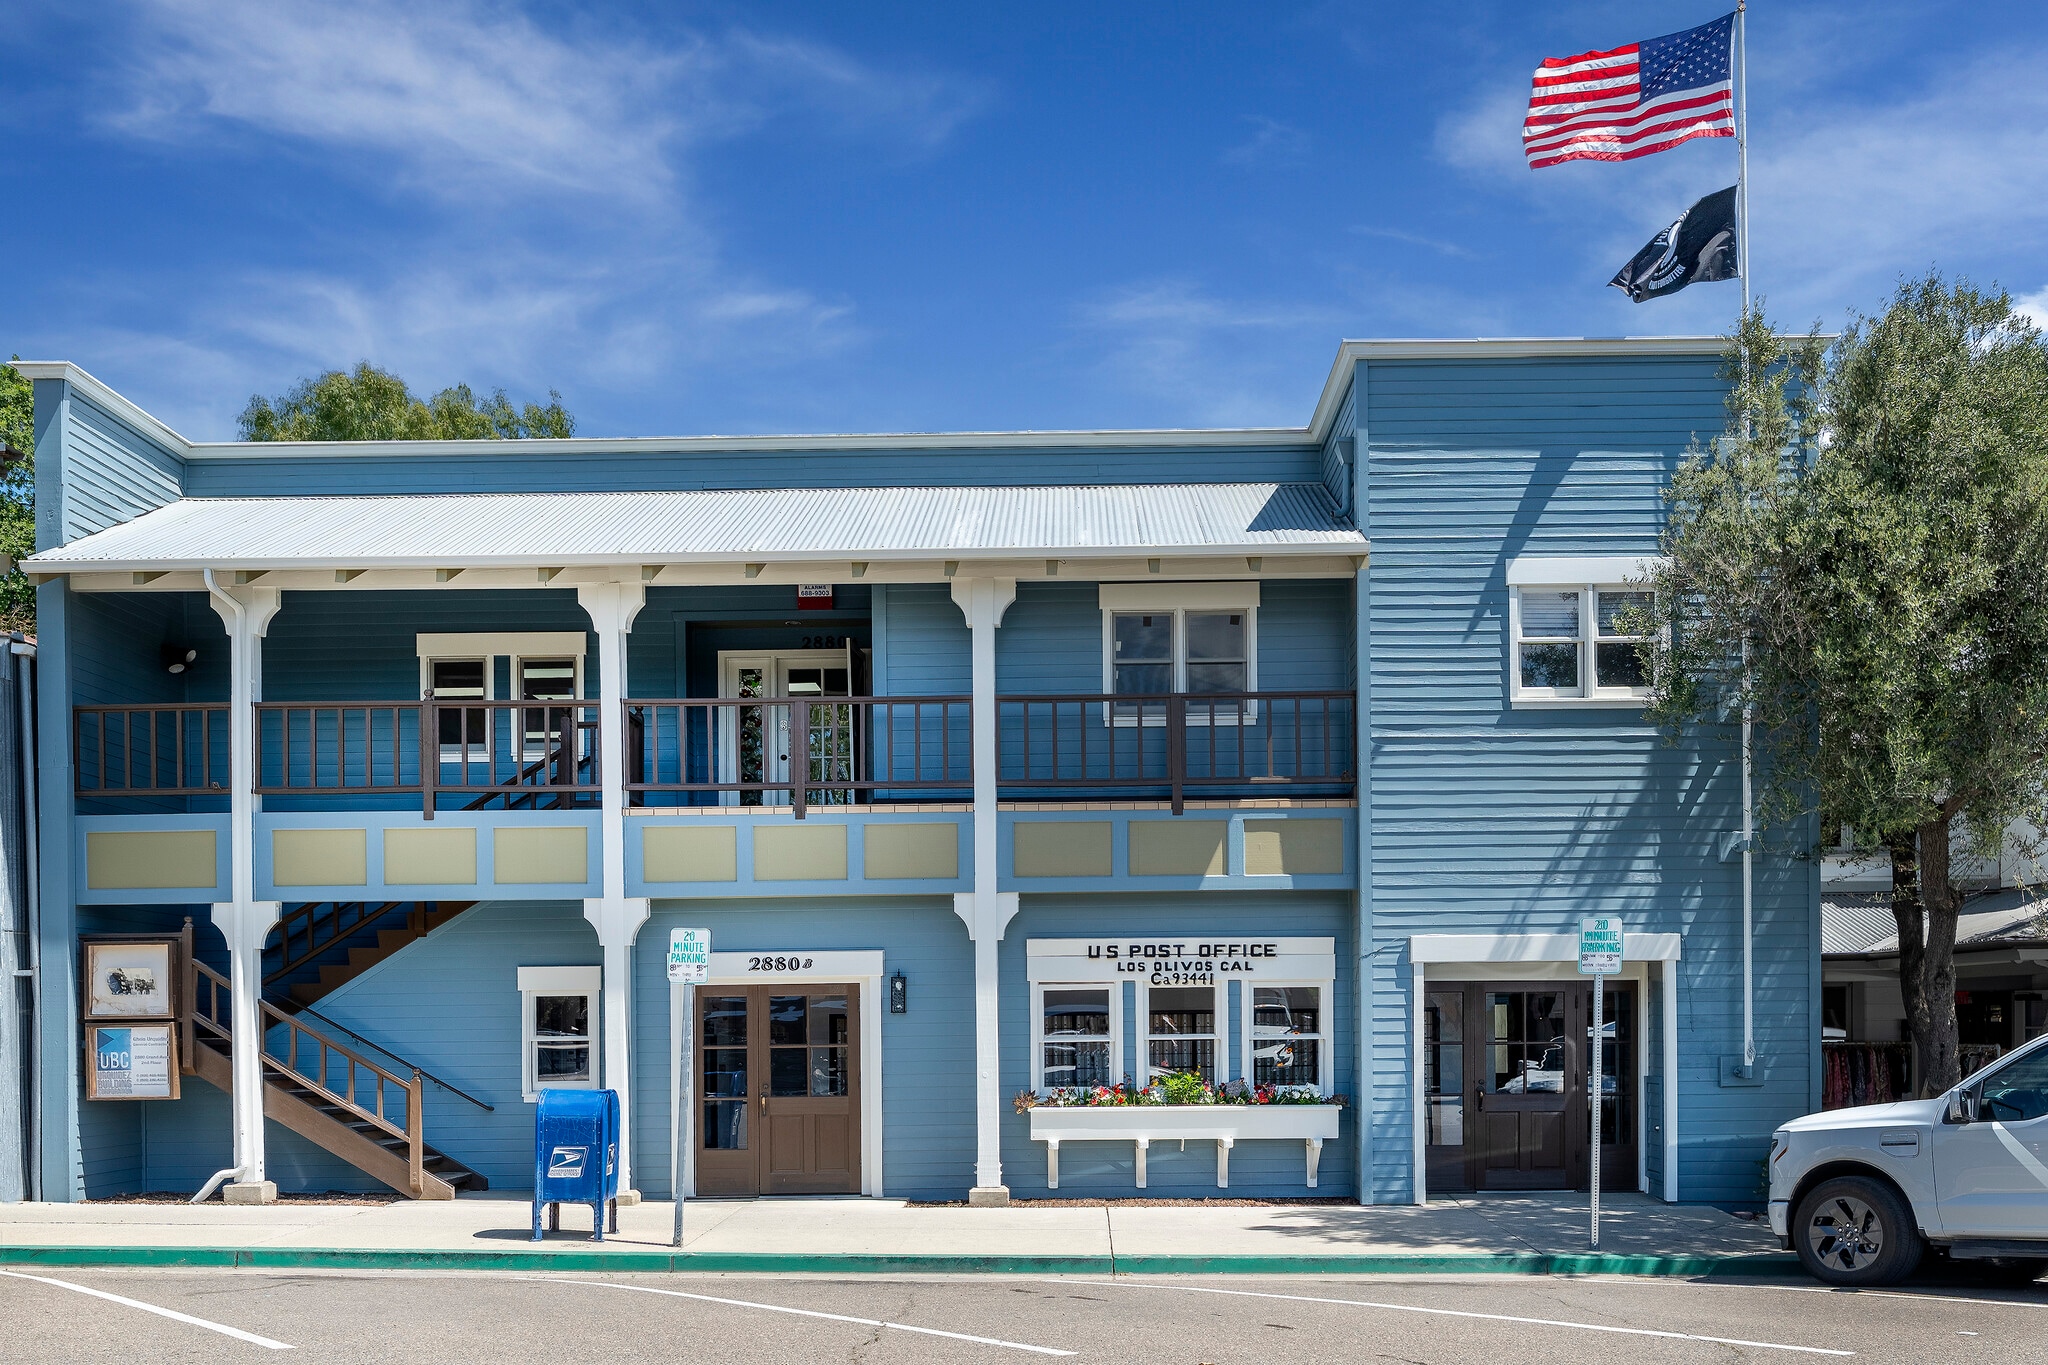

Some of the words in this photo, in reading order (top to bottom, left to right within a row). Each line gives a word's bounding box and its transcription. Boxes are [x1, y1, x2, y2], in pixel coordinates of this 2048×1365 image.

[1594, 919, 1609, 931] 20
[683, 931, 696, 942] 20
[1584, 931, 1619, 941] MINUTE
[673, 942, 705, 952] MINUTE
[1129, 944, 1185, 958] POST
[1198, 943, 1278, 958] OFFICE
[1581, 942, 1621, 953] PARKING
[671, 952, 706, 964] PARKING
[748, 956, 800, 972] 2880
[1117, 961, 1146, 972] LOS
[1153, 961, 1213, 972] OLIVOS
[1220, 961, 1254, 972] CAL
[100, 1051, 129, 1069] UBC
